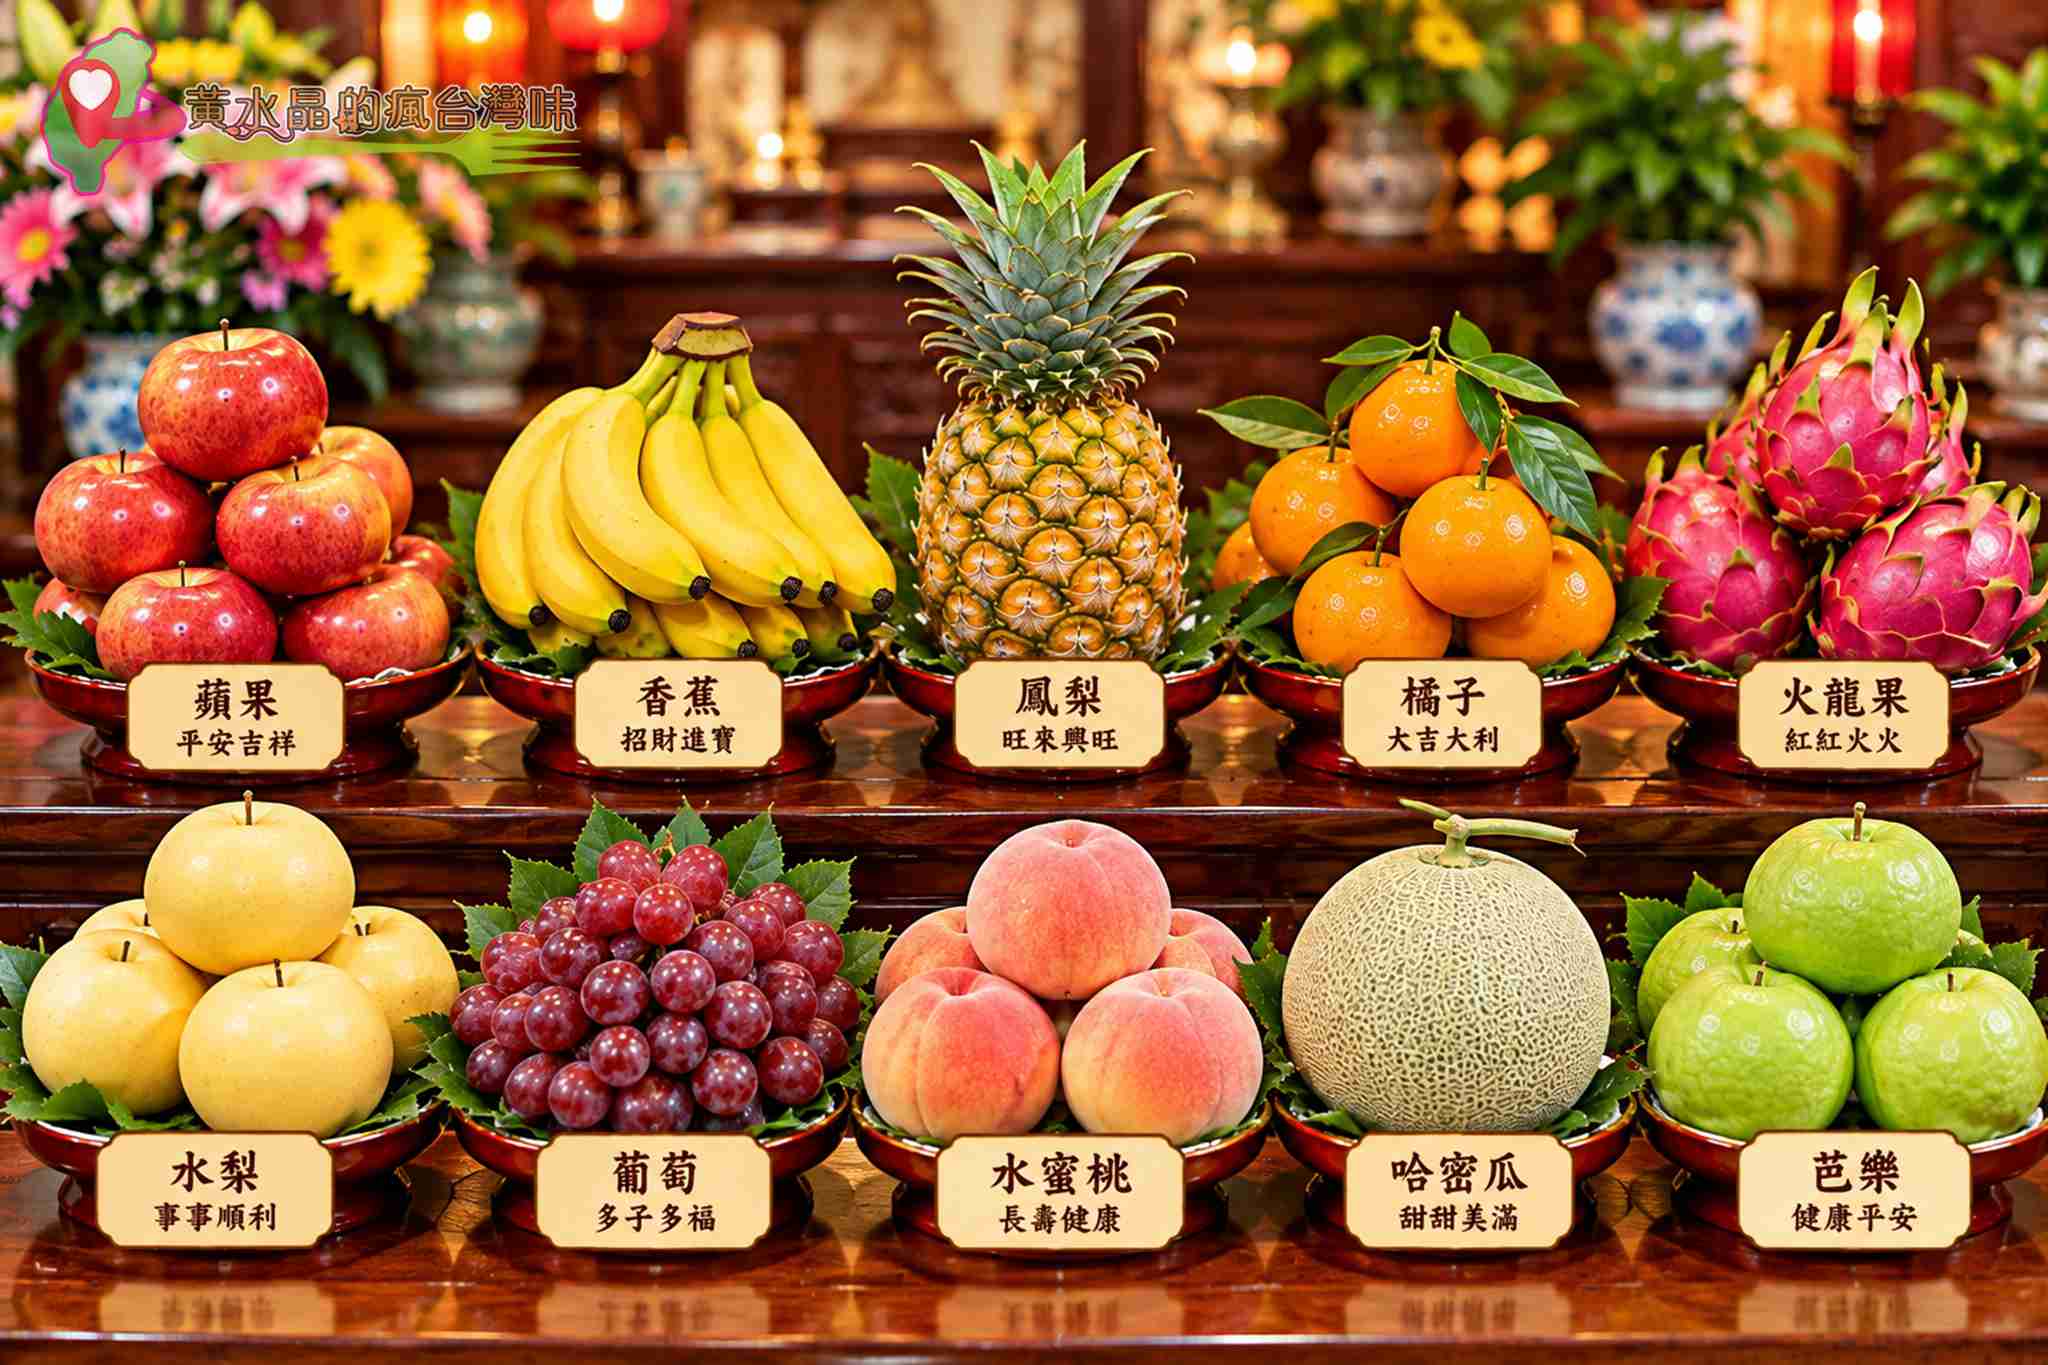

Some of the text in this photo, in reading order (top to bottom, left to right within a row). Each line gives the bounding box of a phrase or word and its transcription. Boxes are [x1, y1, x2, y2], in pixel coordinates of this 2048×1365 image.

[195, 678, 278, 720] 蘋果
[638, 676, 720, 717] 香蕉
[1016, 676, 1100, 717] 鳳梨
[1401, 677, 1485, 717] 橘子
[1780, 677, 1909, 717] 火龍果
[177, 729, 296, 757] 平安吉祥
[621, 725, 735, 754] 招財進寶
[1003, 726, 1118, 753] 旺來興旺
[1388, 726, 1498, 752] 大吉大利
[1785, 727, 1902, 753] 紅紅火火
[171, 1150, 258, 1194] 水梨
[614, 1150, 696, 1195] 葡萄
[992, 1152, 1132, 1196] 水蜜桃
[1392, 1151, 1528, 1194] 哈密瓜
[1814, 1149, 1899, 1194] 芭樂
[154, 1202, 275, 1232] 事事順利
[597, 1204, 715, 1233] 多子多福
[1000, 1204, 1120, 1234] 長壽健康
[1400, 1203, 1517, 1232] 甜甜美滿
[1792, 1203, 1917, 1232] 健康平安
